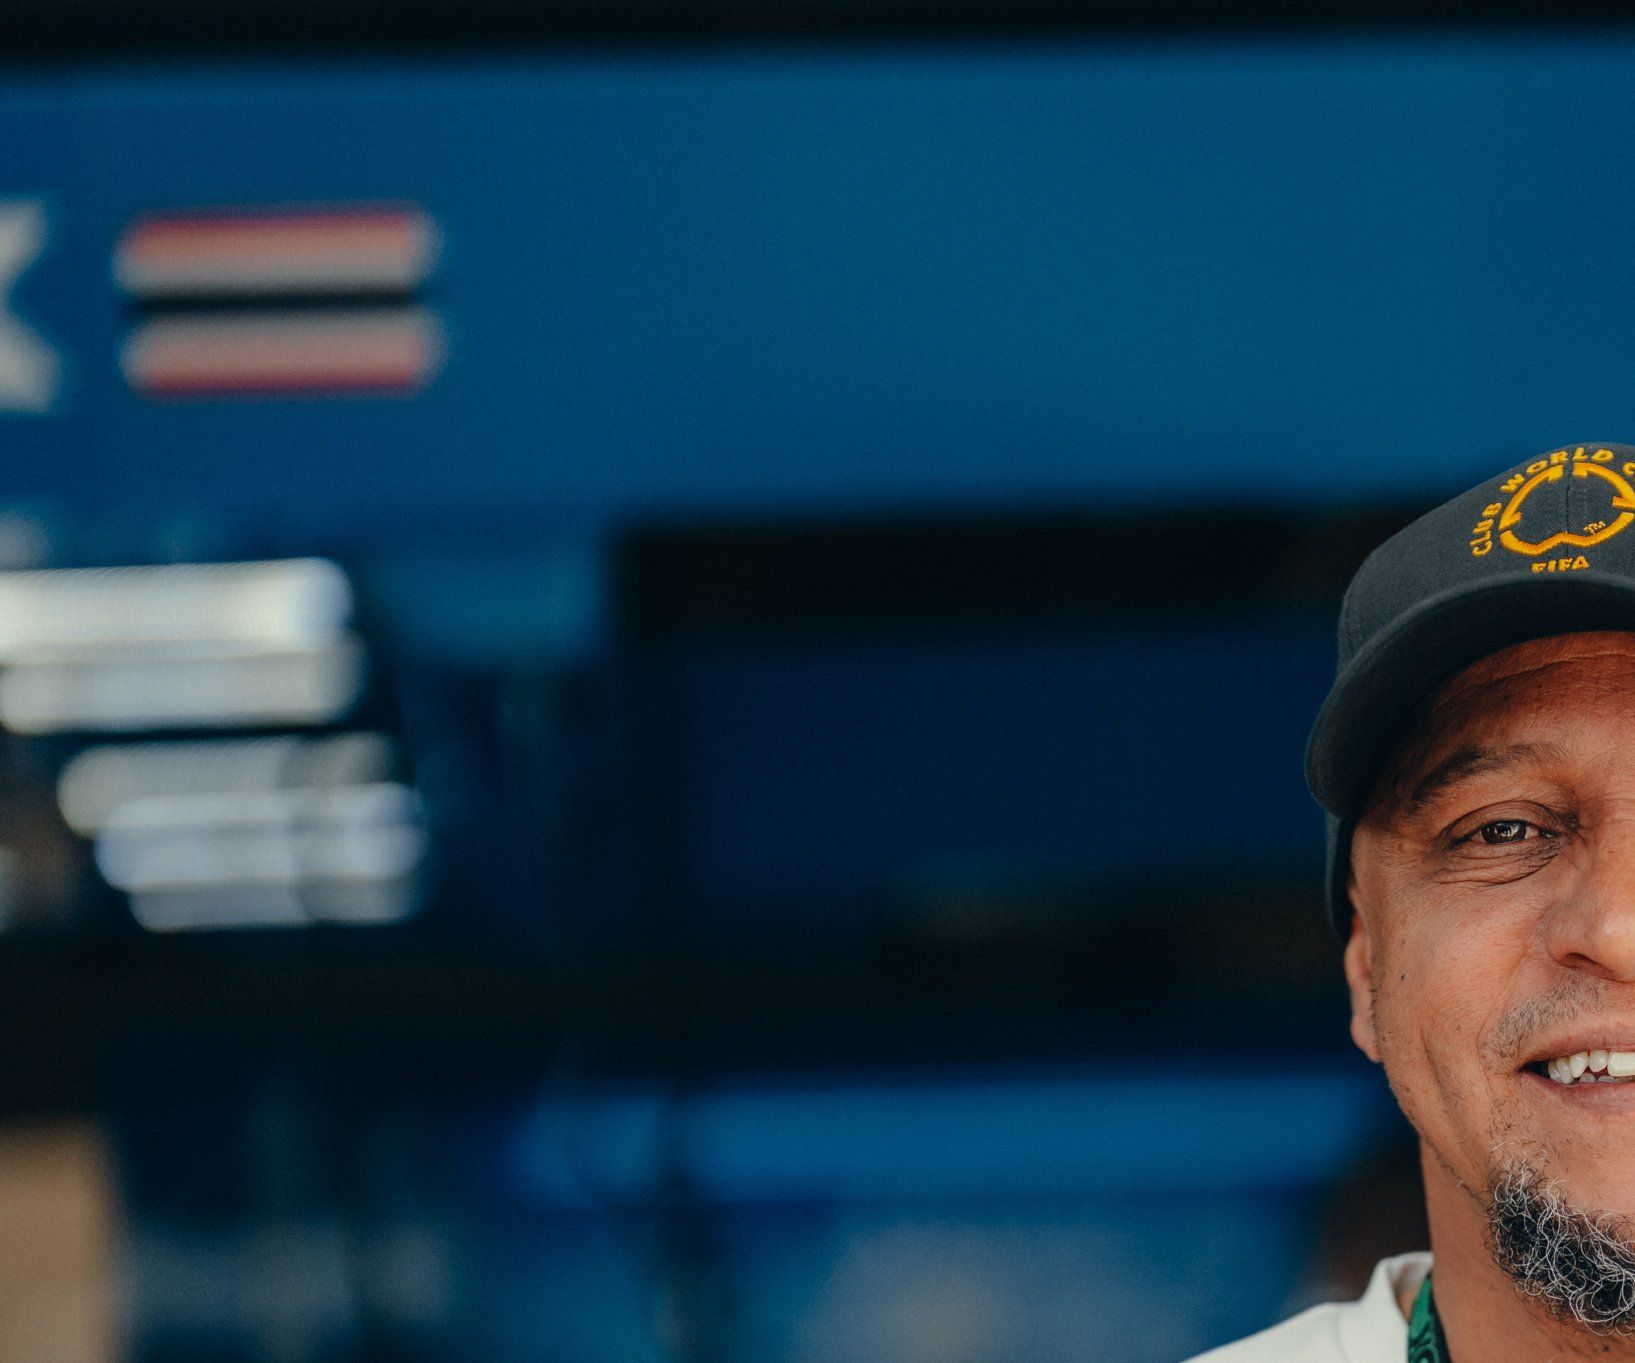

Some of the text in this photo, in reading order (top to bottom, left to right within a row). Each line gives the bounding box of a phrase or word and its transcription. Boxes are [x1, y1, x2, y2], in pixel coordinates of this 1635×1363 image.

[1469, 502, 1502, 557] CLUB
[1500, 447, 1614, 494] WORLD
[1530, 555, 1590, 574] FIFA
